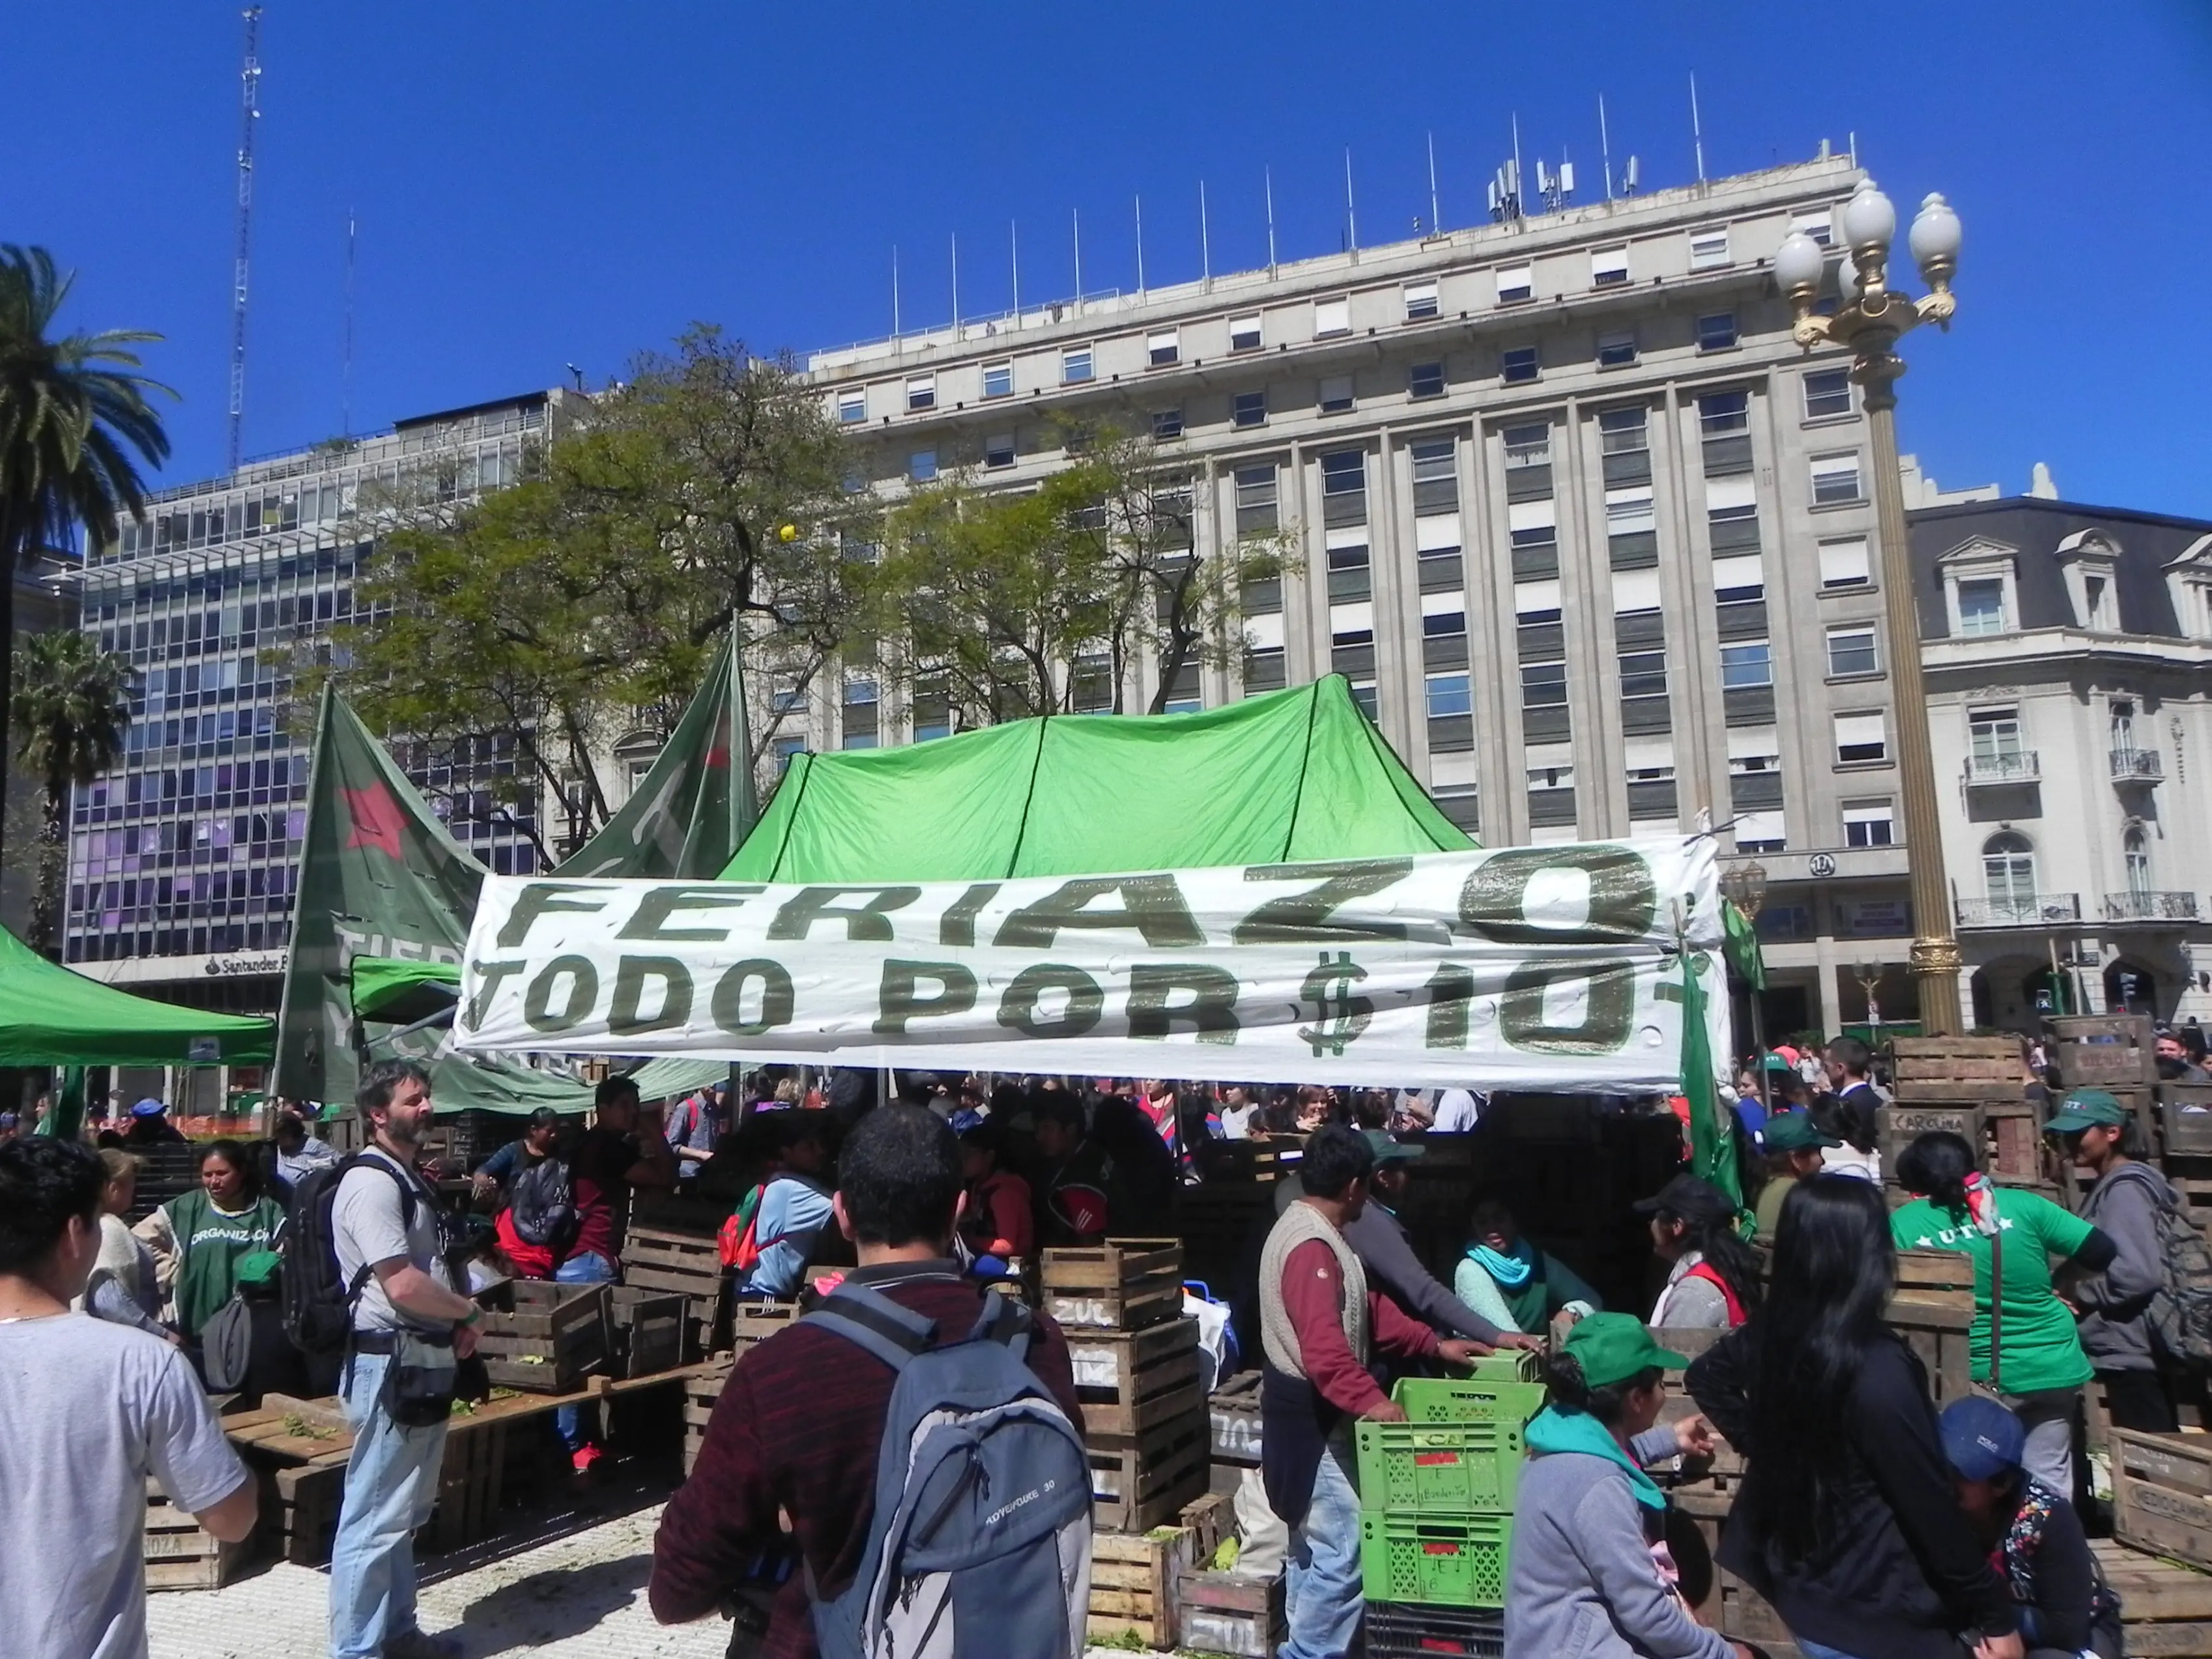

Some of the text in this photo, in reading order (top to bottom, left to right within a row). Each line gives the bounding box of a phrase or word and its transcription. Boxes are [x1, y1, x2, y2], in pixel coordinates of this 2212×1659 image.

[496, 844, 1658, 948] FERIAZO
[222, 955, 278, 973] Santander
[460, 954, 795, 1035] TODO
[872, 959, 1241, 1045] POR
[1042, 1479, 1056, 1492] 30
